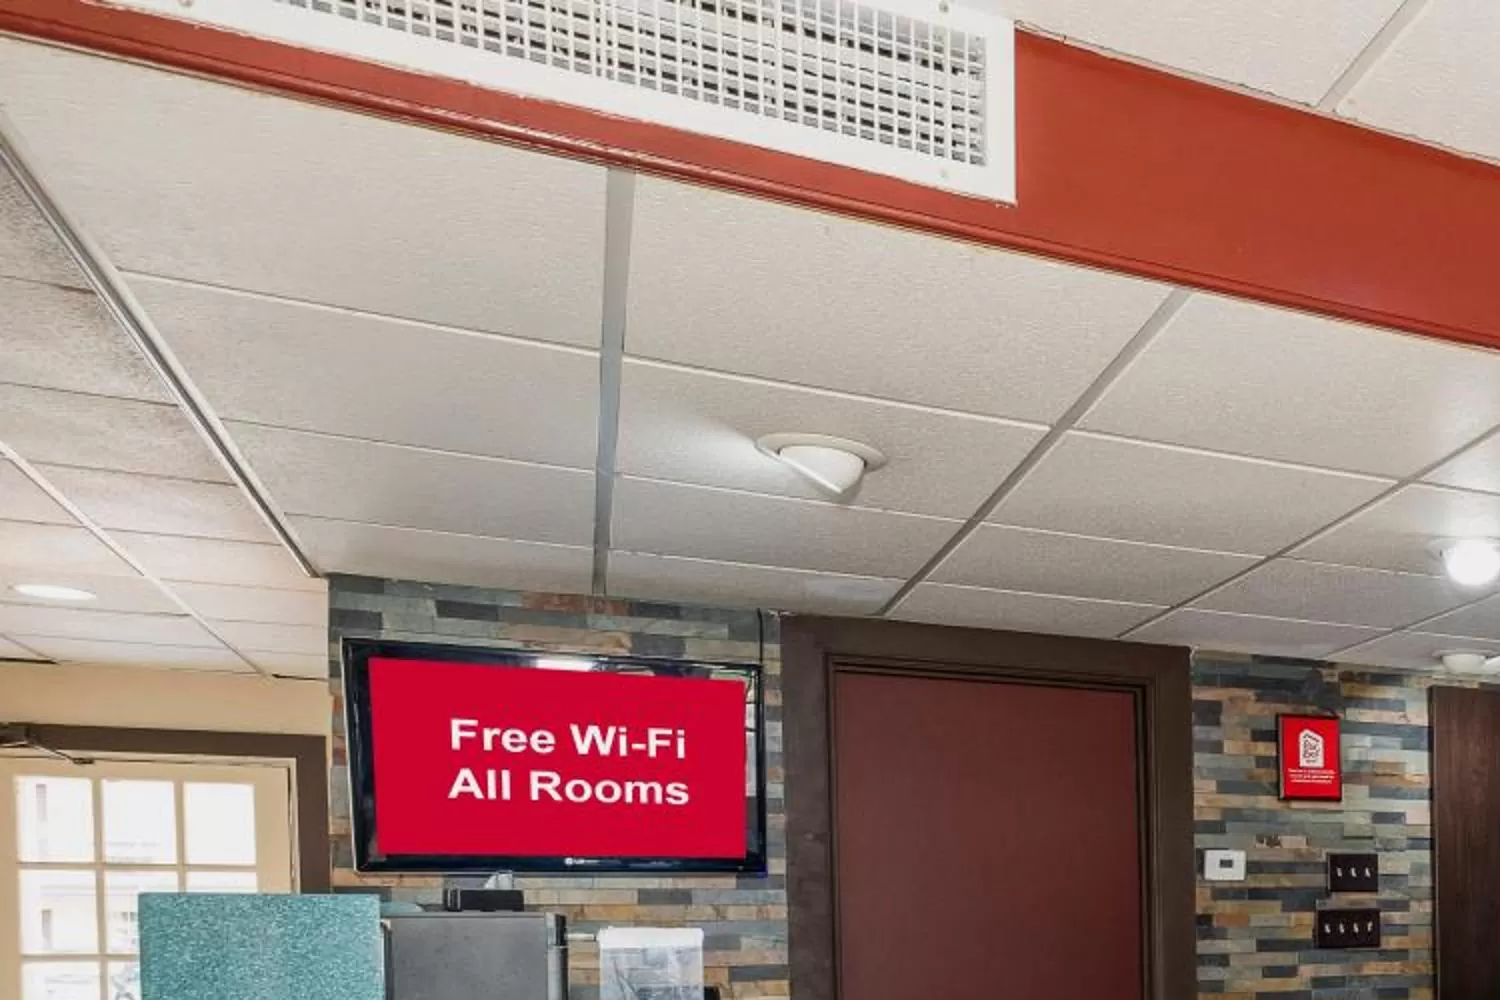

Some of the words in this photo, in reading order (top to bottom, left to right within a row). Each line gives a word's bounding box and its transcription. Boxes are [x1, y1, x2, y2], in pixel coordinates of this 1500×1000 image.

[450, 718, 557, 755] Free
[569, 723, 687, 760] Wi-Fi
[448, 767, 512, 802] All
[528, 770, 690, 806] Rooms
